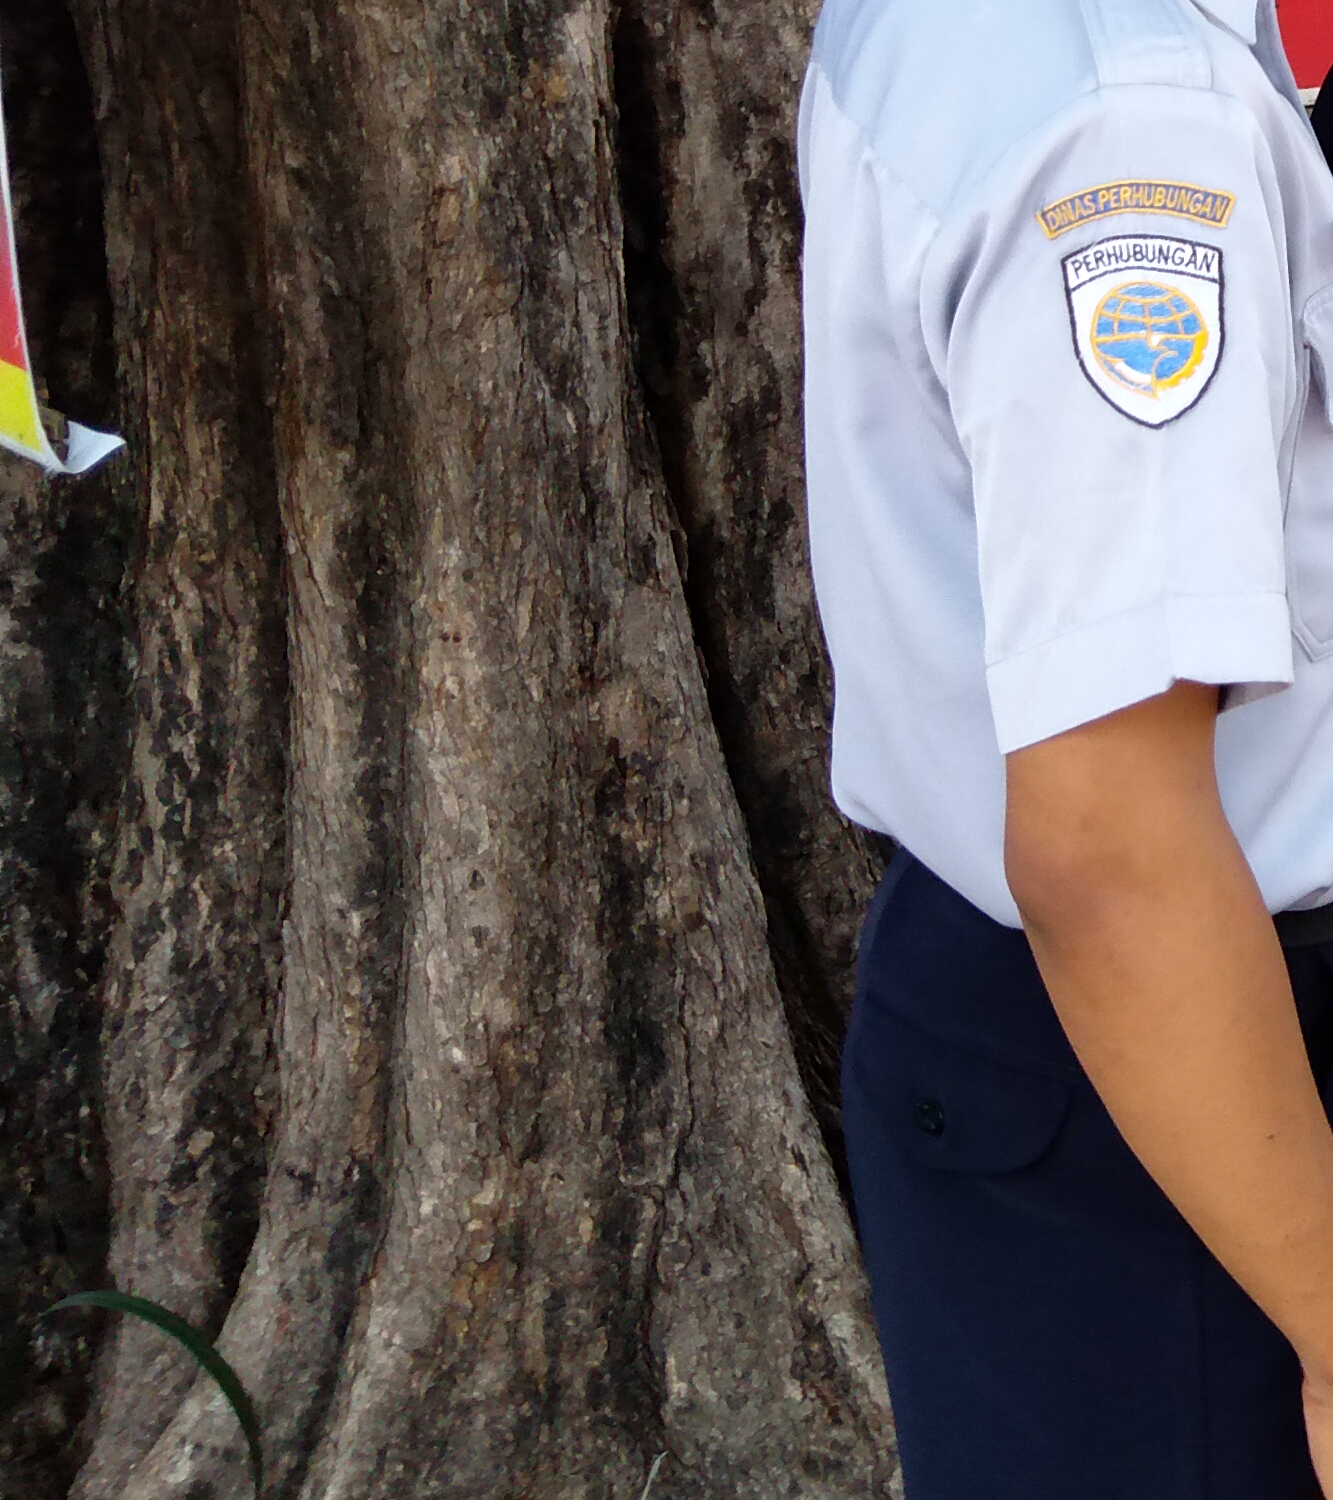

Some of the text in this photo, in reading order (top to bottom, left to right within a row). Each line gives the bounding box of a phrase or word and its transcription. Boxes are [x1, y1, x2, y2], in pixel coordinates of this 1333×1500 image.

[1046, 185, 1228, 230] DINAS PERHUBUNGAN
[1071, 243, 1216, 279] PERHUBUNGAN
